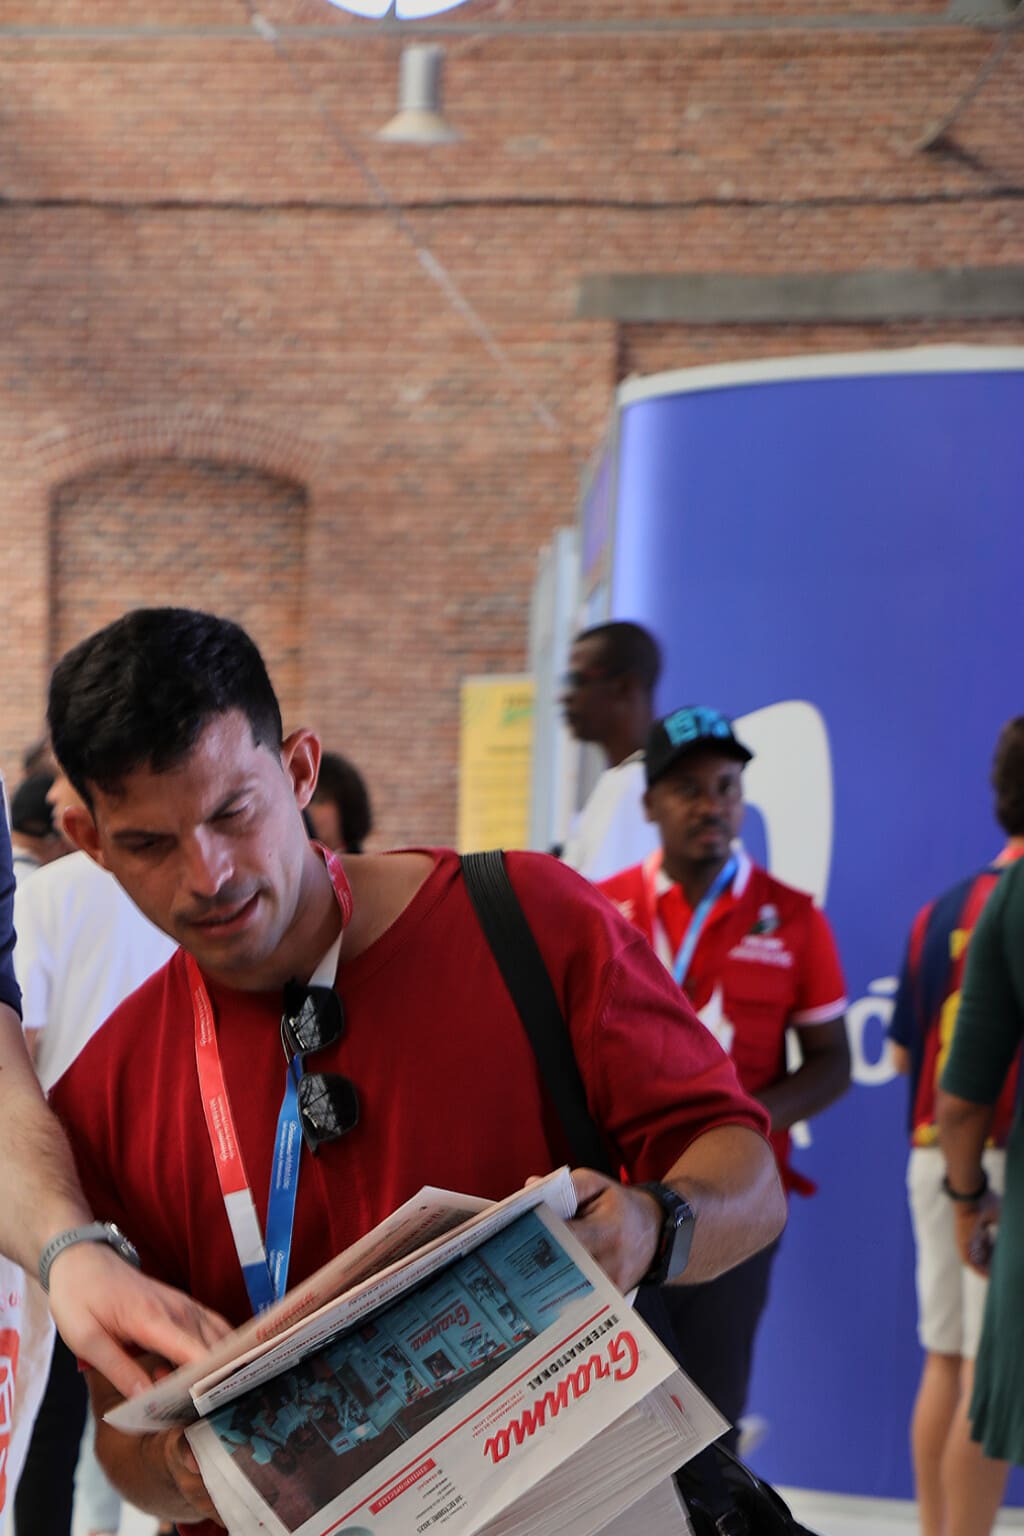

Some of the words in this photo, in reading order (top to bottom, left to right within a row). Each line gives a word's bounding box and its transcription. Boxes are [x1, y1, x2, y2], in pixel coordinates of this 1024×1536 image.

[410, 1303, 470, 1351] Granma
[527, 1314, 619, 1391] INTERNATIONAL
[483, 1330, 640, 1464] Granma
